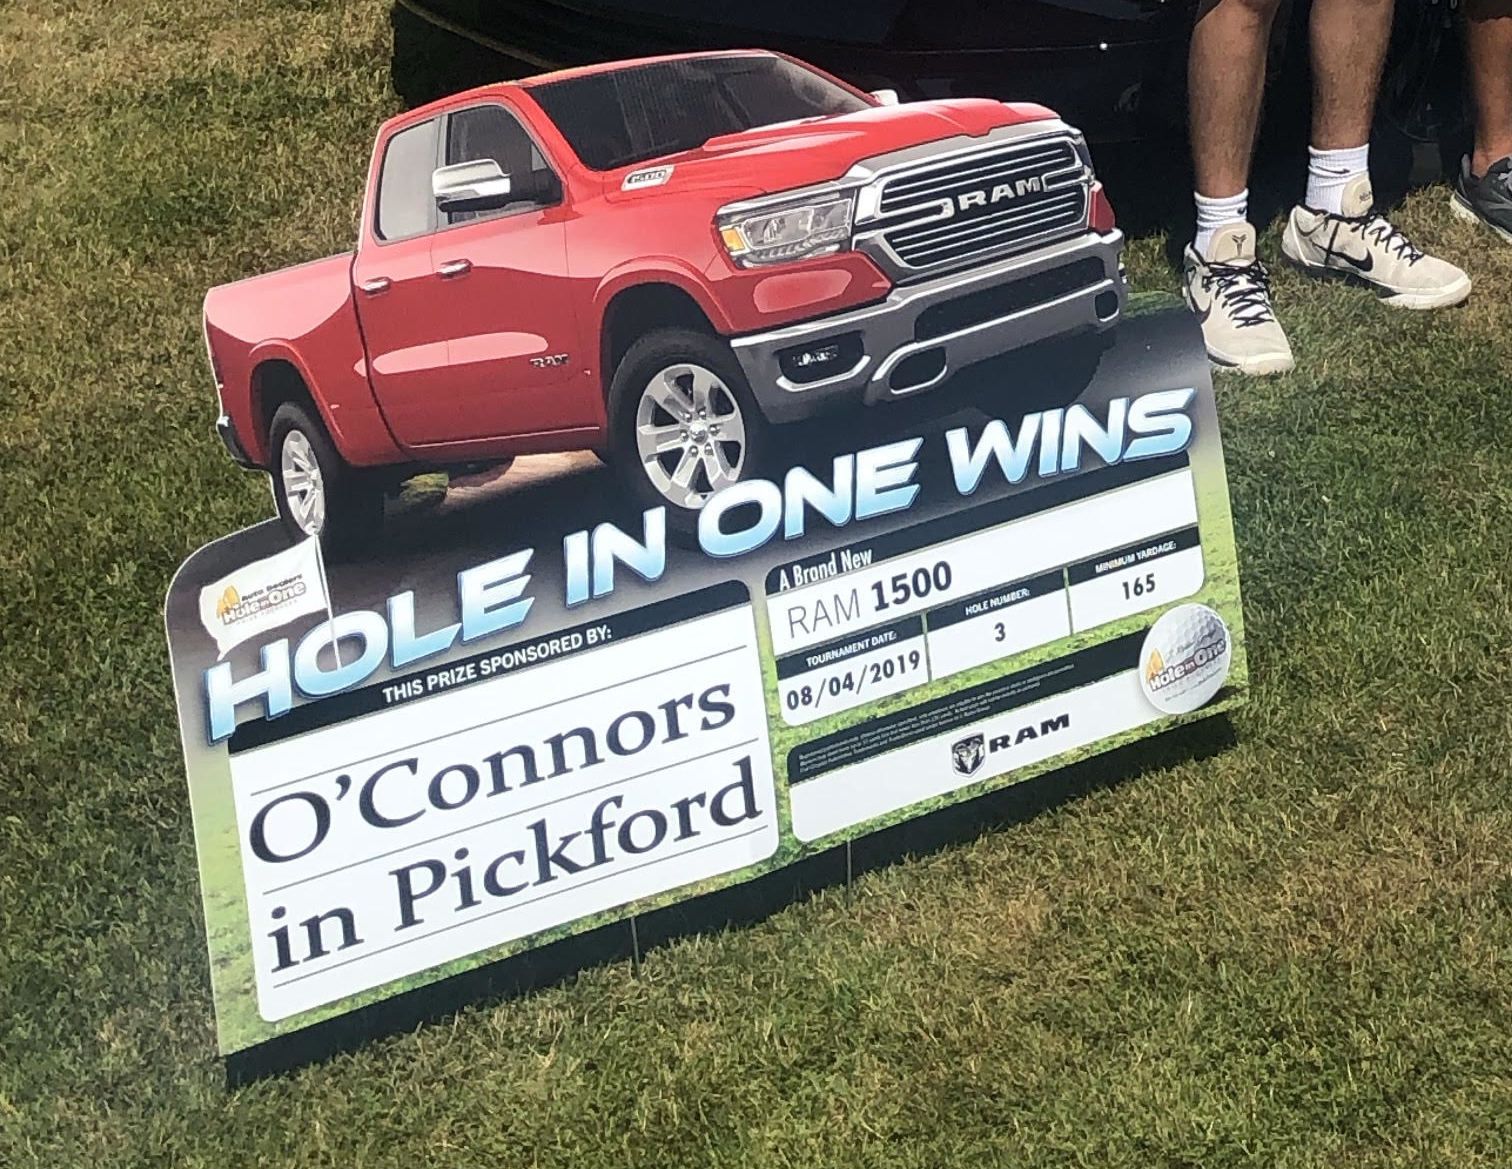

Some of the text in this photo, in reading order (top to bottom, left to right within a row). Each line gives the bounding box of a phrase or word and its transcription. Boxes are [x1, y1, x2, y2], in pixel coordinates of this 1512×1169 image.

[957, 176, 1041, 212] RAM
[203, 387, 1198, 744] HOLE IN ONE WINS
[779, 548, 873, 592] A Brand New
[1095, 540, 1177, 573] MINIMUM YARDAGE:
[222, 599, 261, 626] Hole
[268, 581, 307, 605] One
[787, 560, 953, 639] RAM 1500
[965, 587, 1031, 616] HOLE NUMBER:
[1122, 573, 1156, 601] 165
[805, 630, 898, 667] TOURNAMENT DATE:
[994, 622, 1007, 642] 3
[383, 624, 613, 705] THIS PRIZE SPONSORED BY:
[786, 650, 920, 711] 08/04/2019
[1149, 662, 1185, 692] Hole
[1193, 638, 1226, 668] One
[988, 713, 1071, 754] RAM
[248, 683, 736, 864] O'Connors
[267, 756, 762, 973] in Pickford
